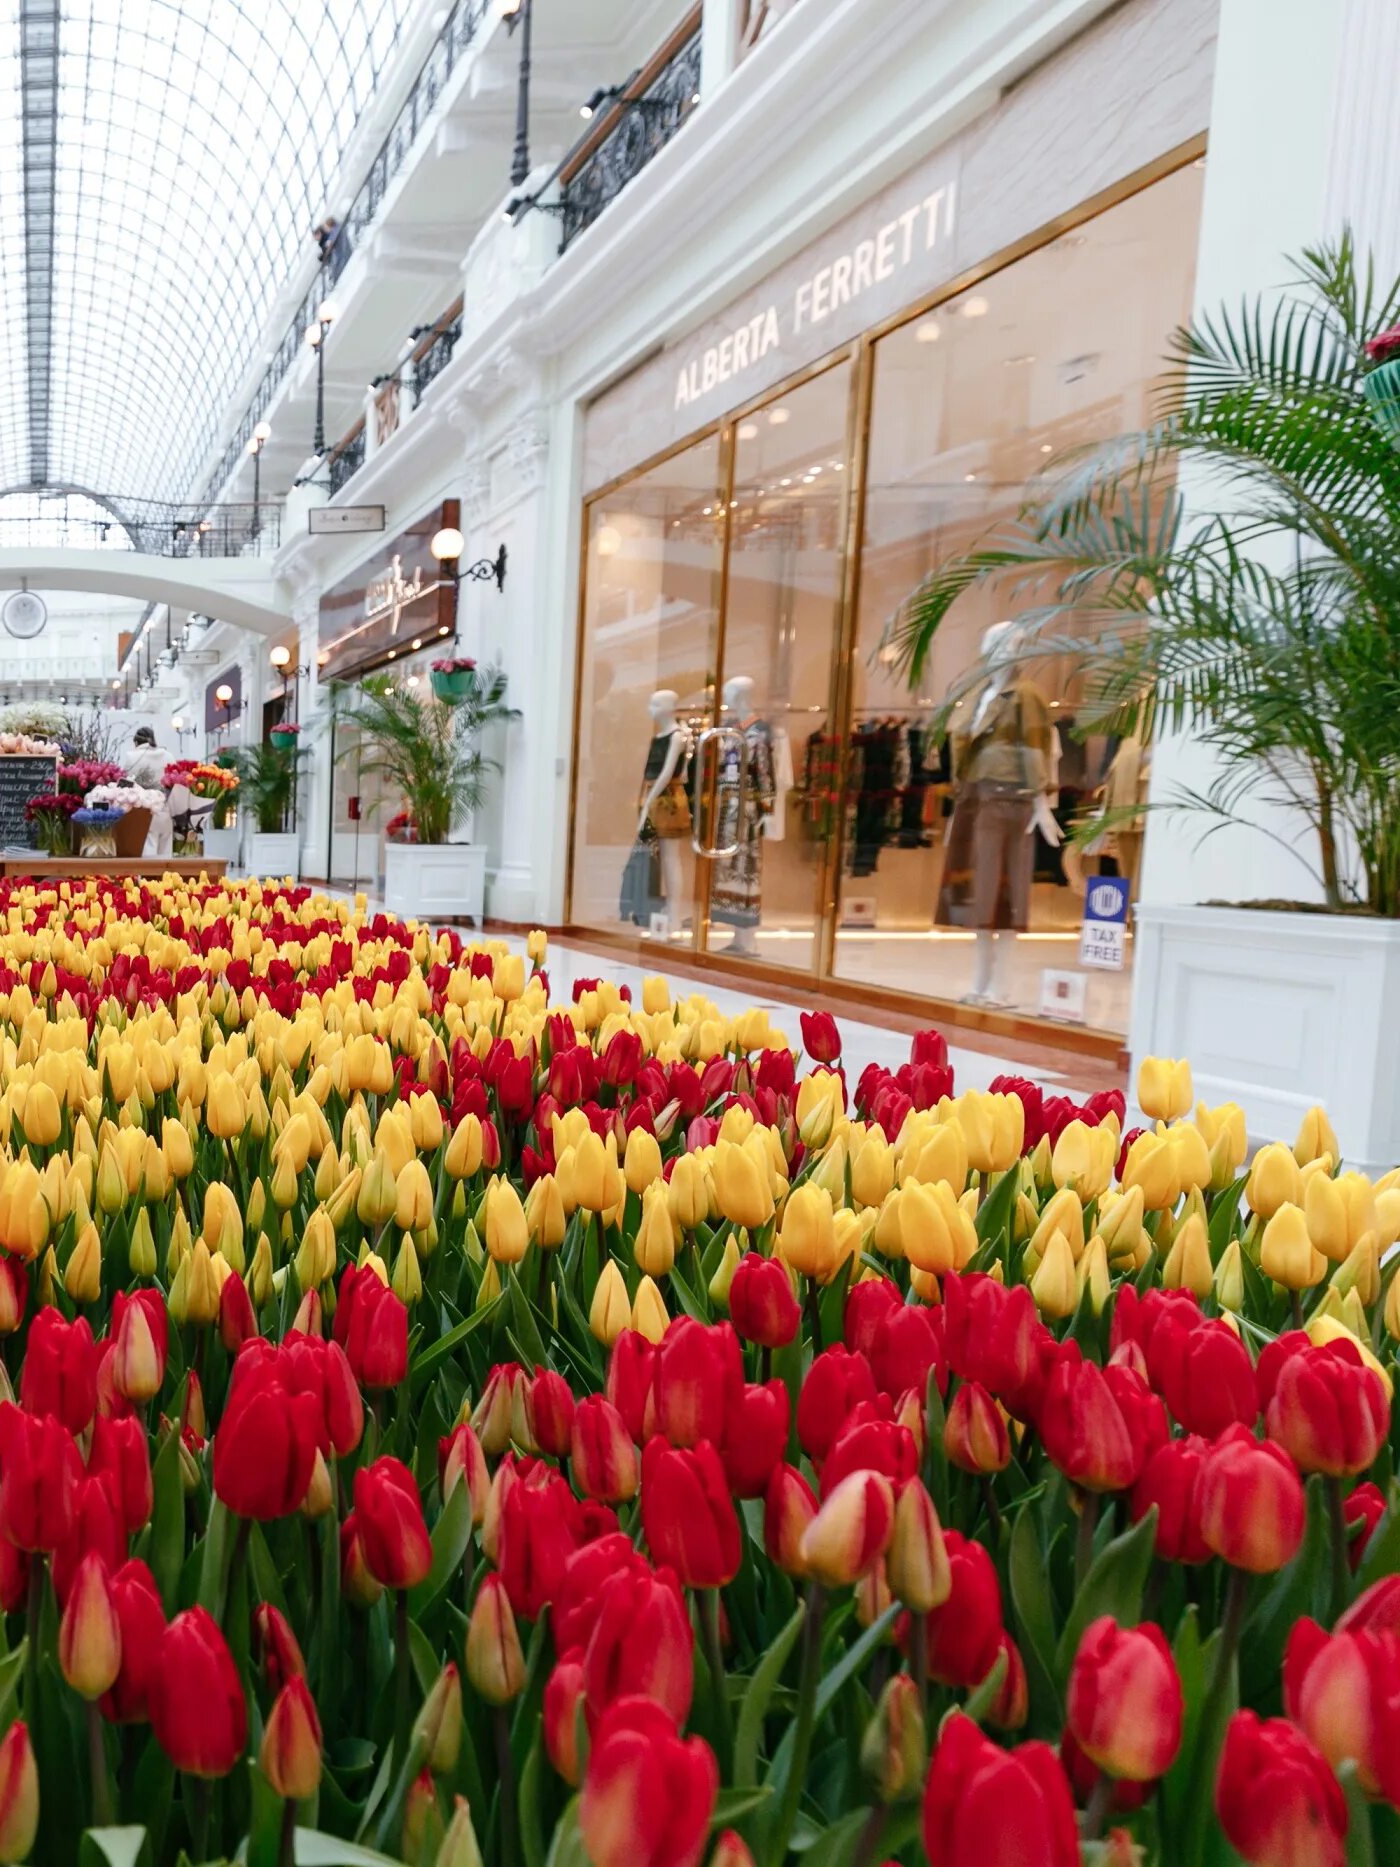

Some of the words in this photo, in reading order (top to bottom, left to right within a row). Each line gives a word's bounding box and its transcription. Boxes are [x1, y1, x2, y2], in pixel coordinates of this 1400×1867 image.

[674, 306, 779, 410] ALBERTA
[792, 181, 956, 333] FERRETTI
[1090, 927, 1116, 942] TAX
[1084, 944, 1121, 962] FREE
